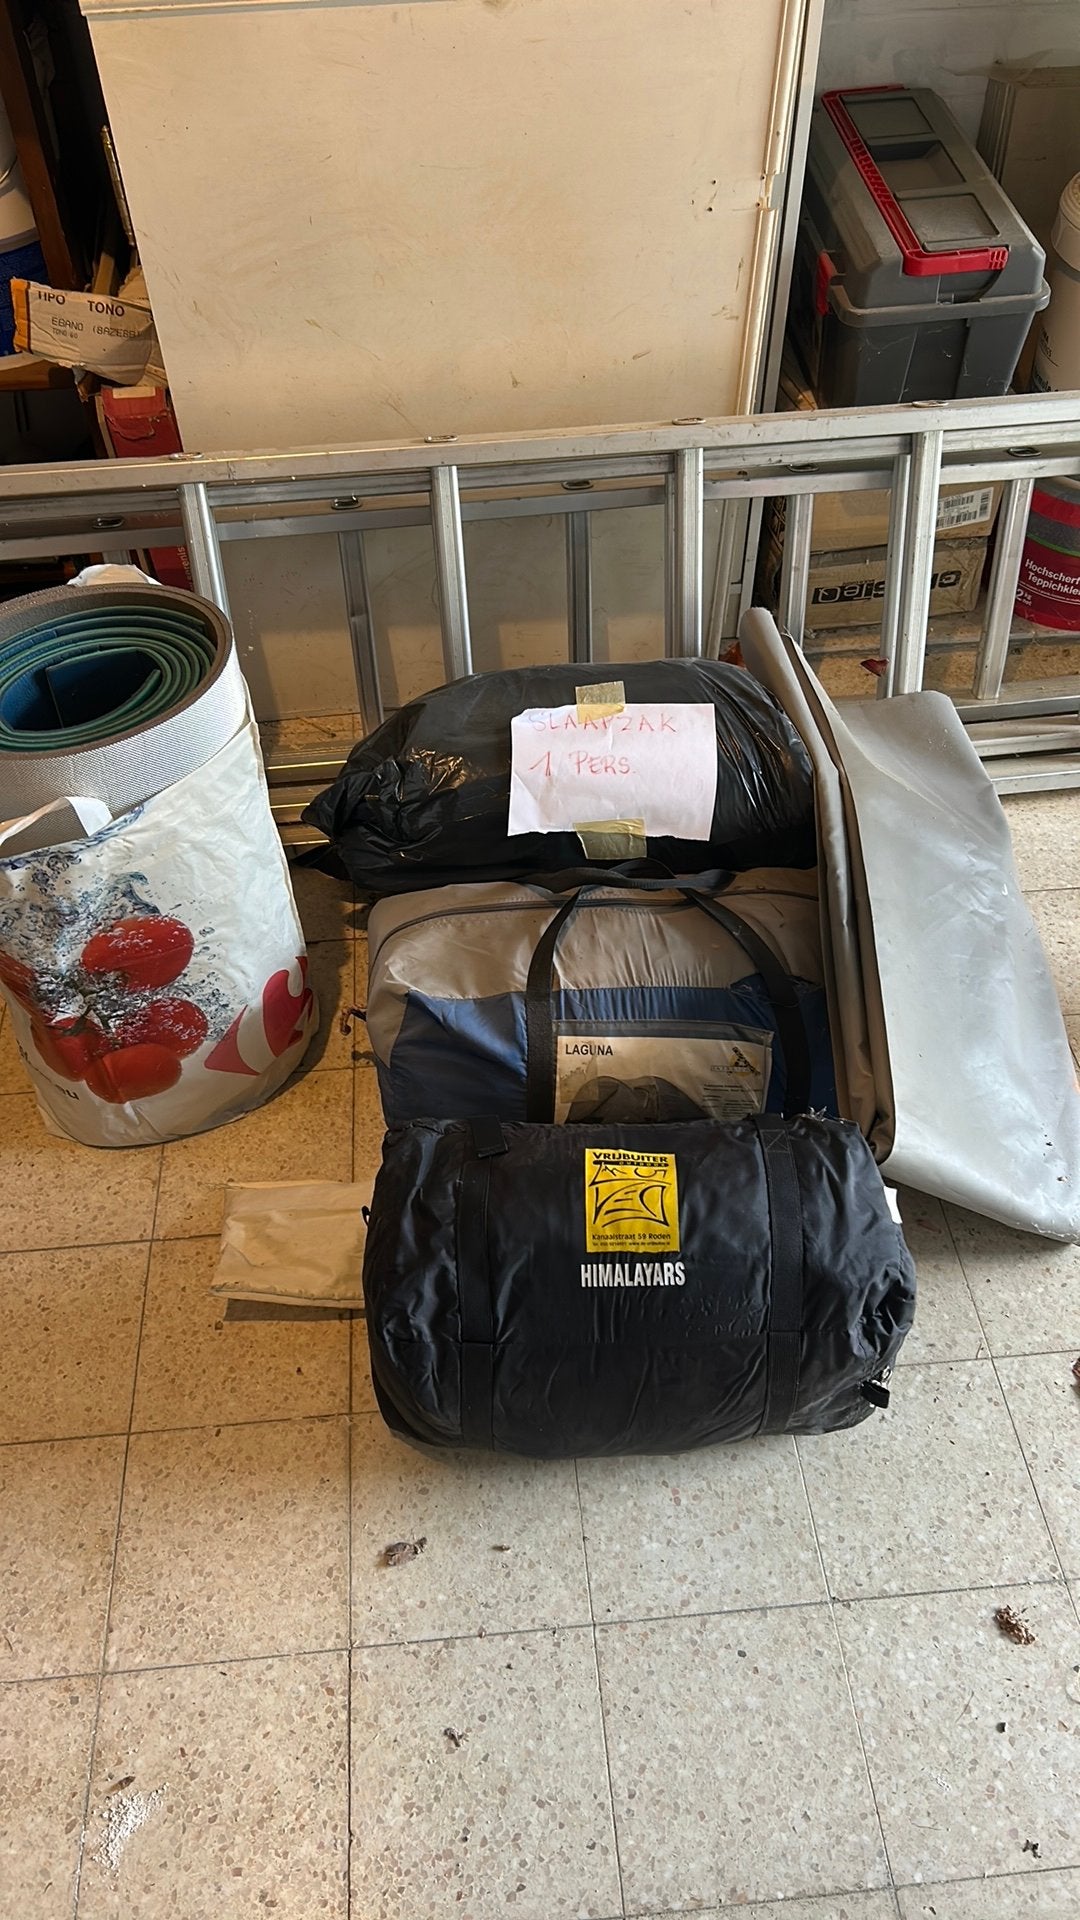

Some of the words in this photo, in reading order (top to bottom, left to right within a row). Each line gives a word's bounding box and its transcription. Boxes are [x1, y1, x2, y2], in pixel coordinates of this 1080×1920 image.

[87, 300, 125, 317] TONO
[1028, 571, 1080, 596] Teppichkle
[530, 751, 551, 777] 1
[565, 1044, 614, 1056] LAGUNA
[592, 1152, 668, 1163] VRIJBUITER
[592, 1232, 636, 1240] Kanaalstraat
[637, 1232, 647, 1240] 59
[648, 1232, 671, 1240] Roden
[580, 1261, 686, 1288] HIMALAYARS
